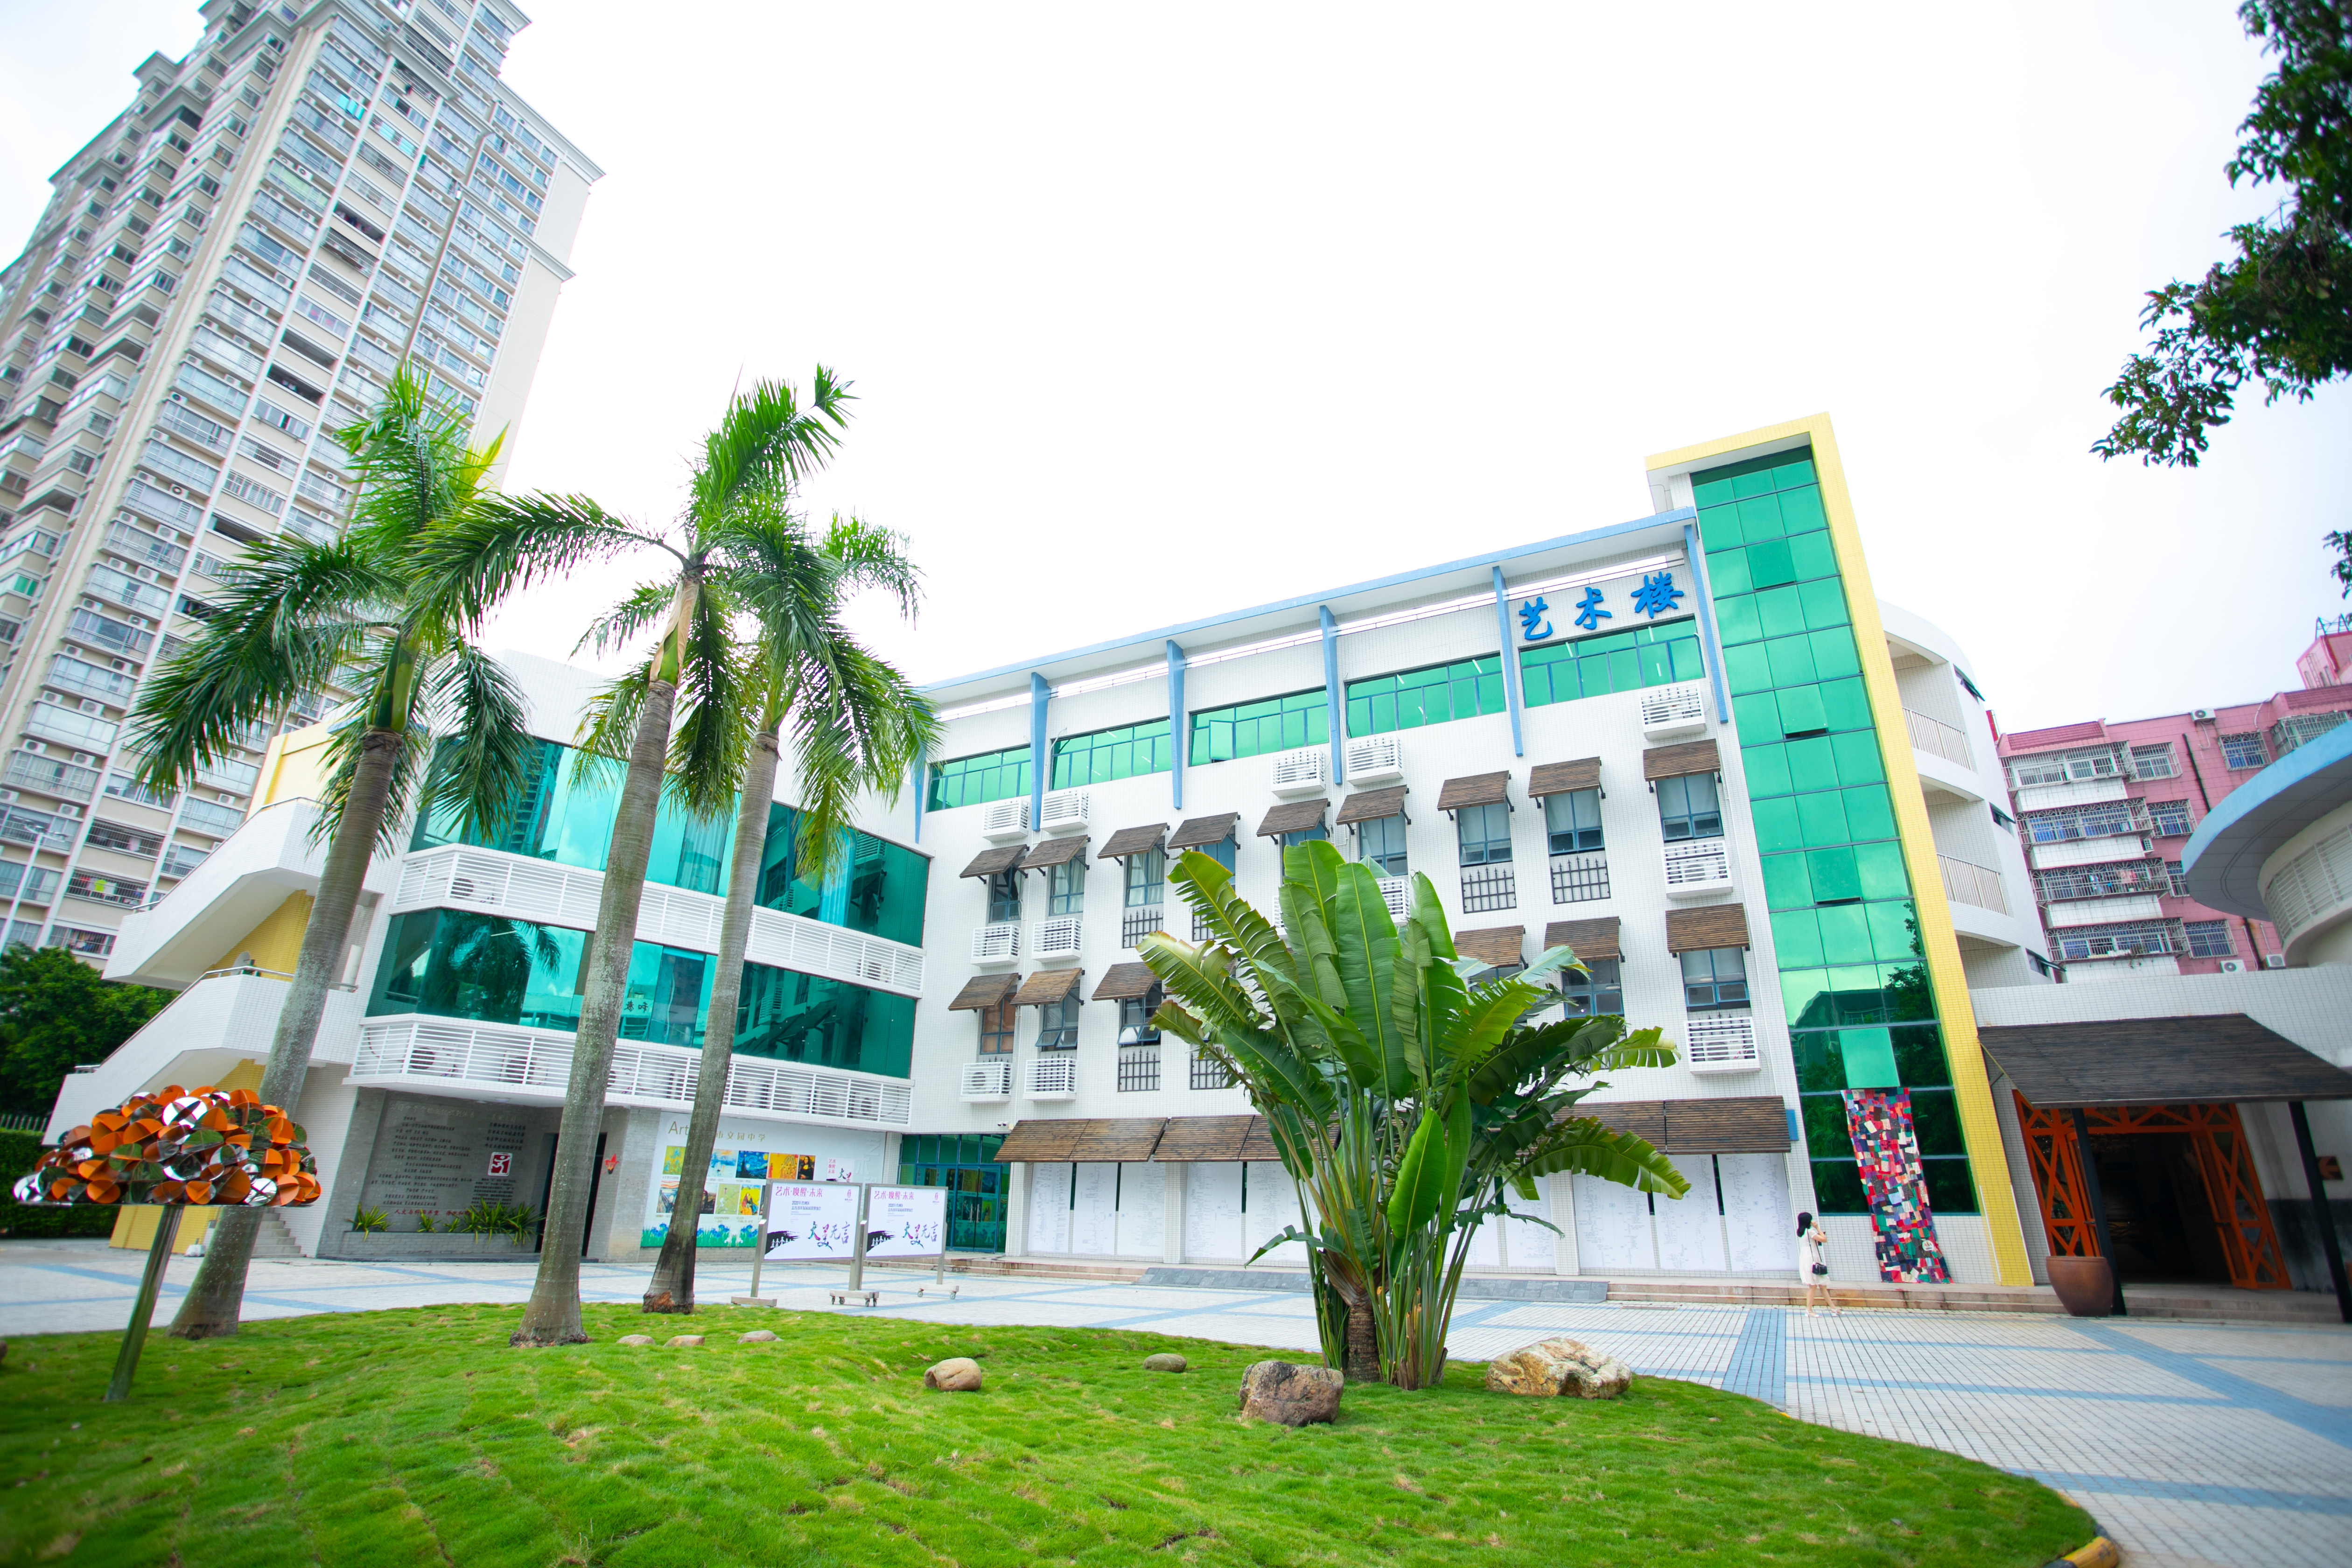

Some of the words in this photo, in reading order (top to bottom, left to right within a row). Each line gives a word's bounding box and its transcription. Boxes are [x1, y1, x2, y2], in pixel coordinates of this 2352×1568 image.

[1519, 571, 1684, 640] 艺术楼
[668, 1121, 689, 1135] Art
